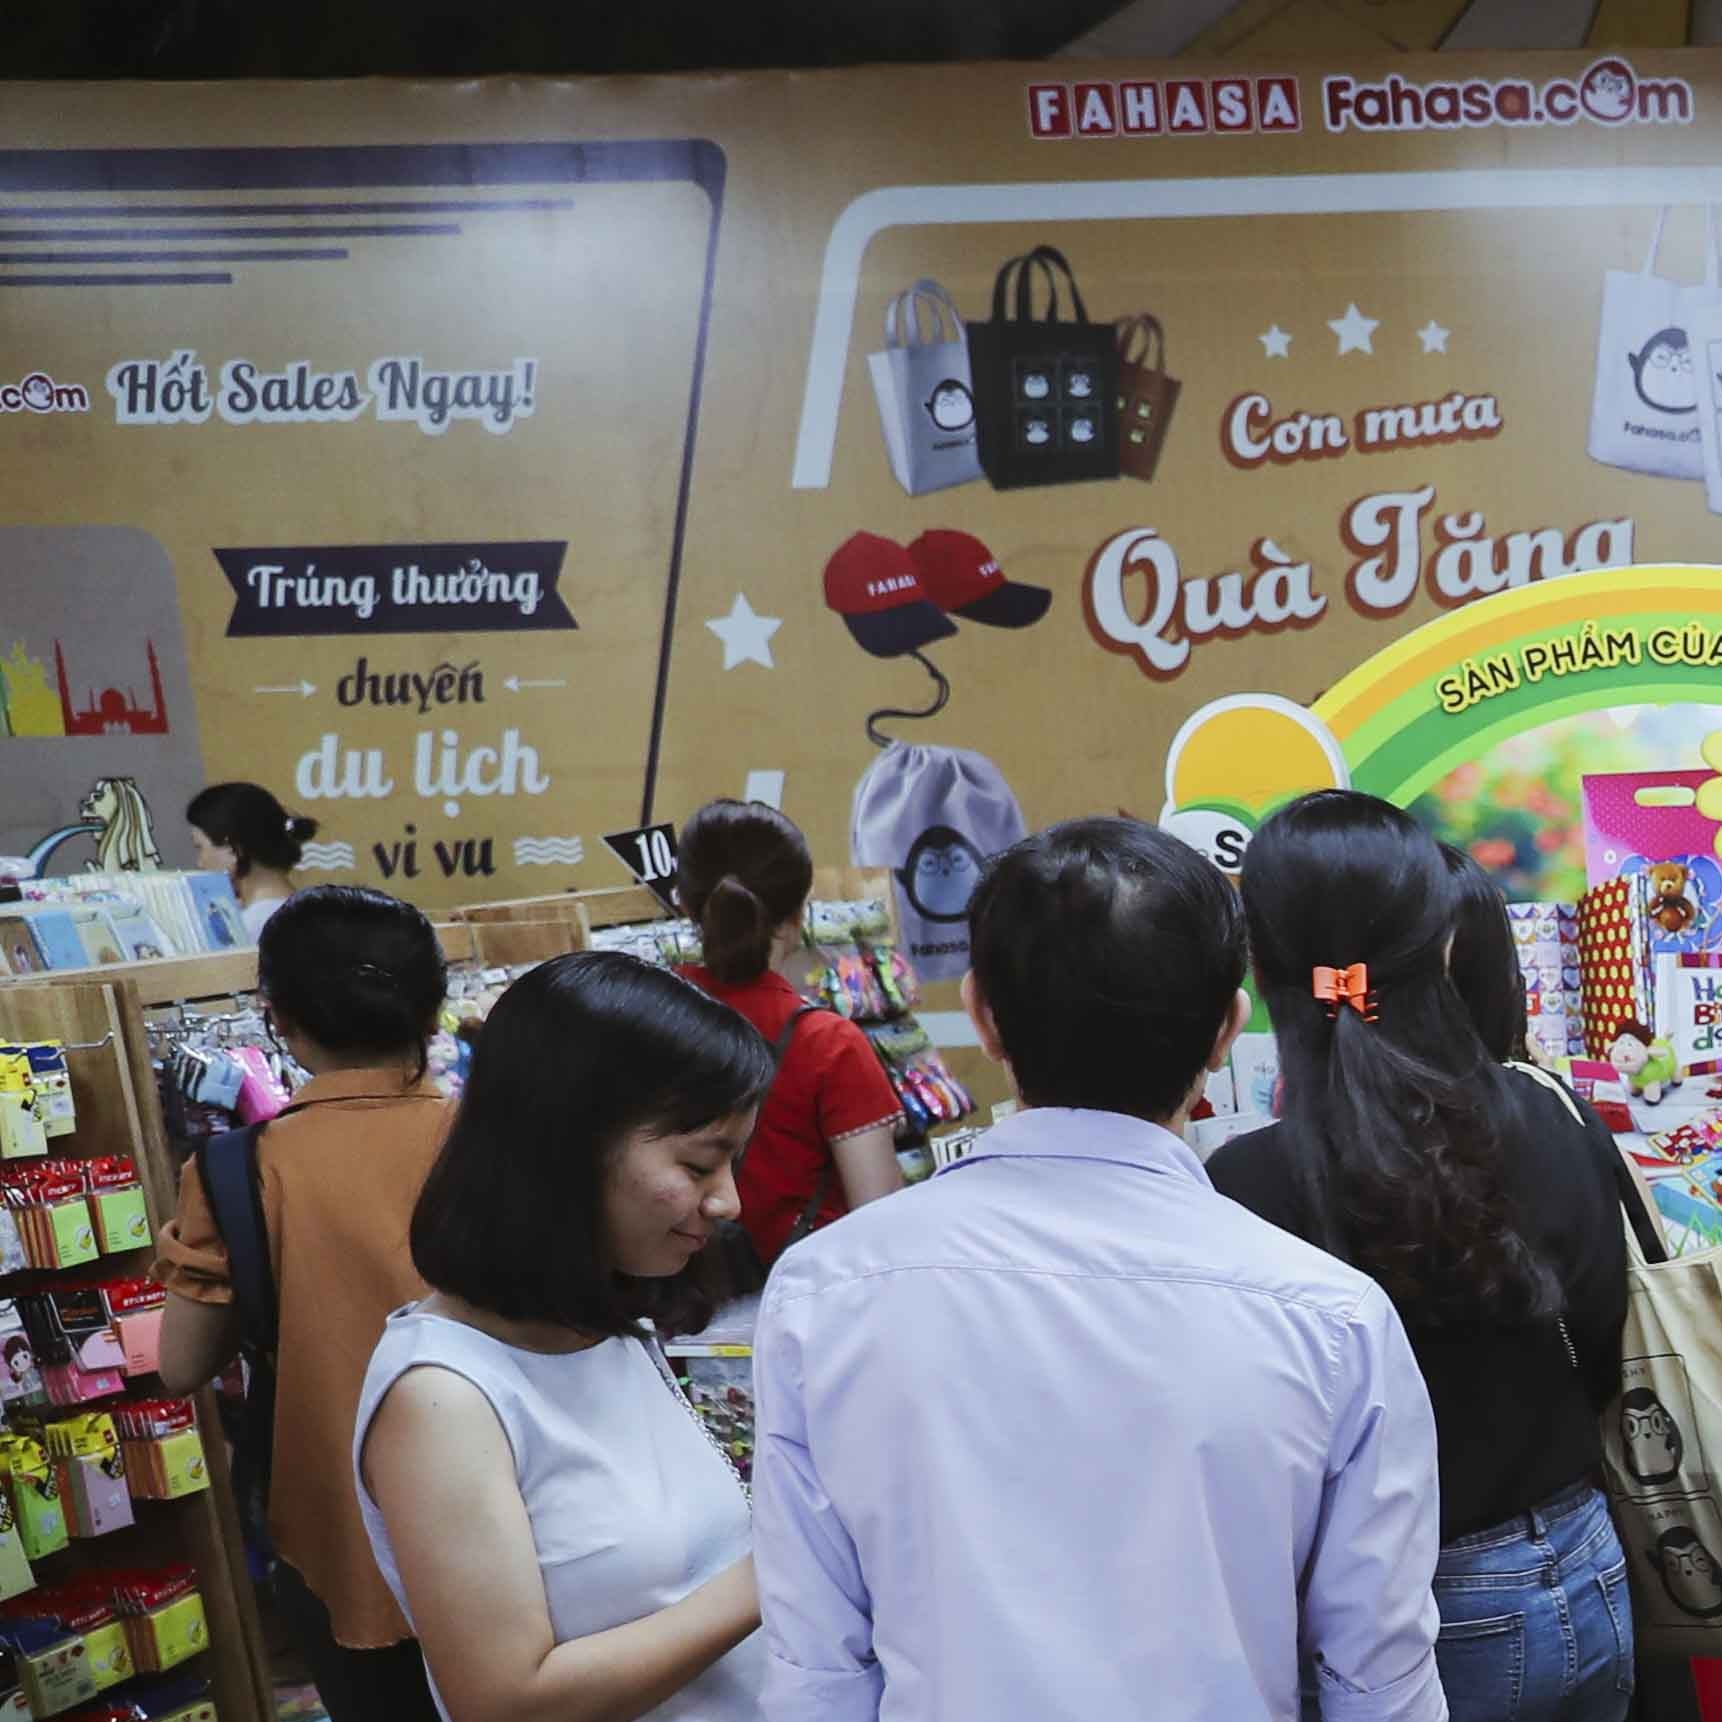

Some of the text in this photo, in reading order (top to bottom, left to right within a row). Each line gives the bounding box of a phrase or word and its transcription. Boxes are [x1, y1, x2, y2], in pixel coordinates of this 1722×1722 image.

[1029, 77, 1299, 136] FAHASA
[116, 352, 210, 420] Hốt
[226, 360, 364, 415] Sales
[378, 358, 537, 430] Ngay!
[1230, 391, 1502, 460] Cơn mưa
[246, 556, 544, 618] Trúng thưởng
[1090, 526, 1326, 673] Quà
[336, 656, 486, 713] chuyến
[1437, 657, 1521, 714] SẢN
[1526, 622, 1641, 688] PHẨM
[296, 728, 550, 818] du lịch
[374, 824, 497, 879] vi vu
